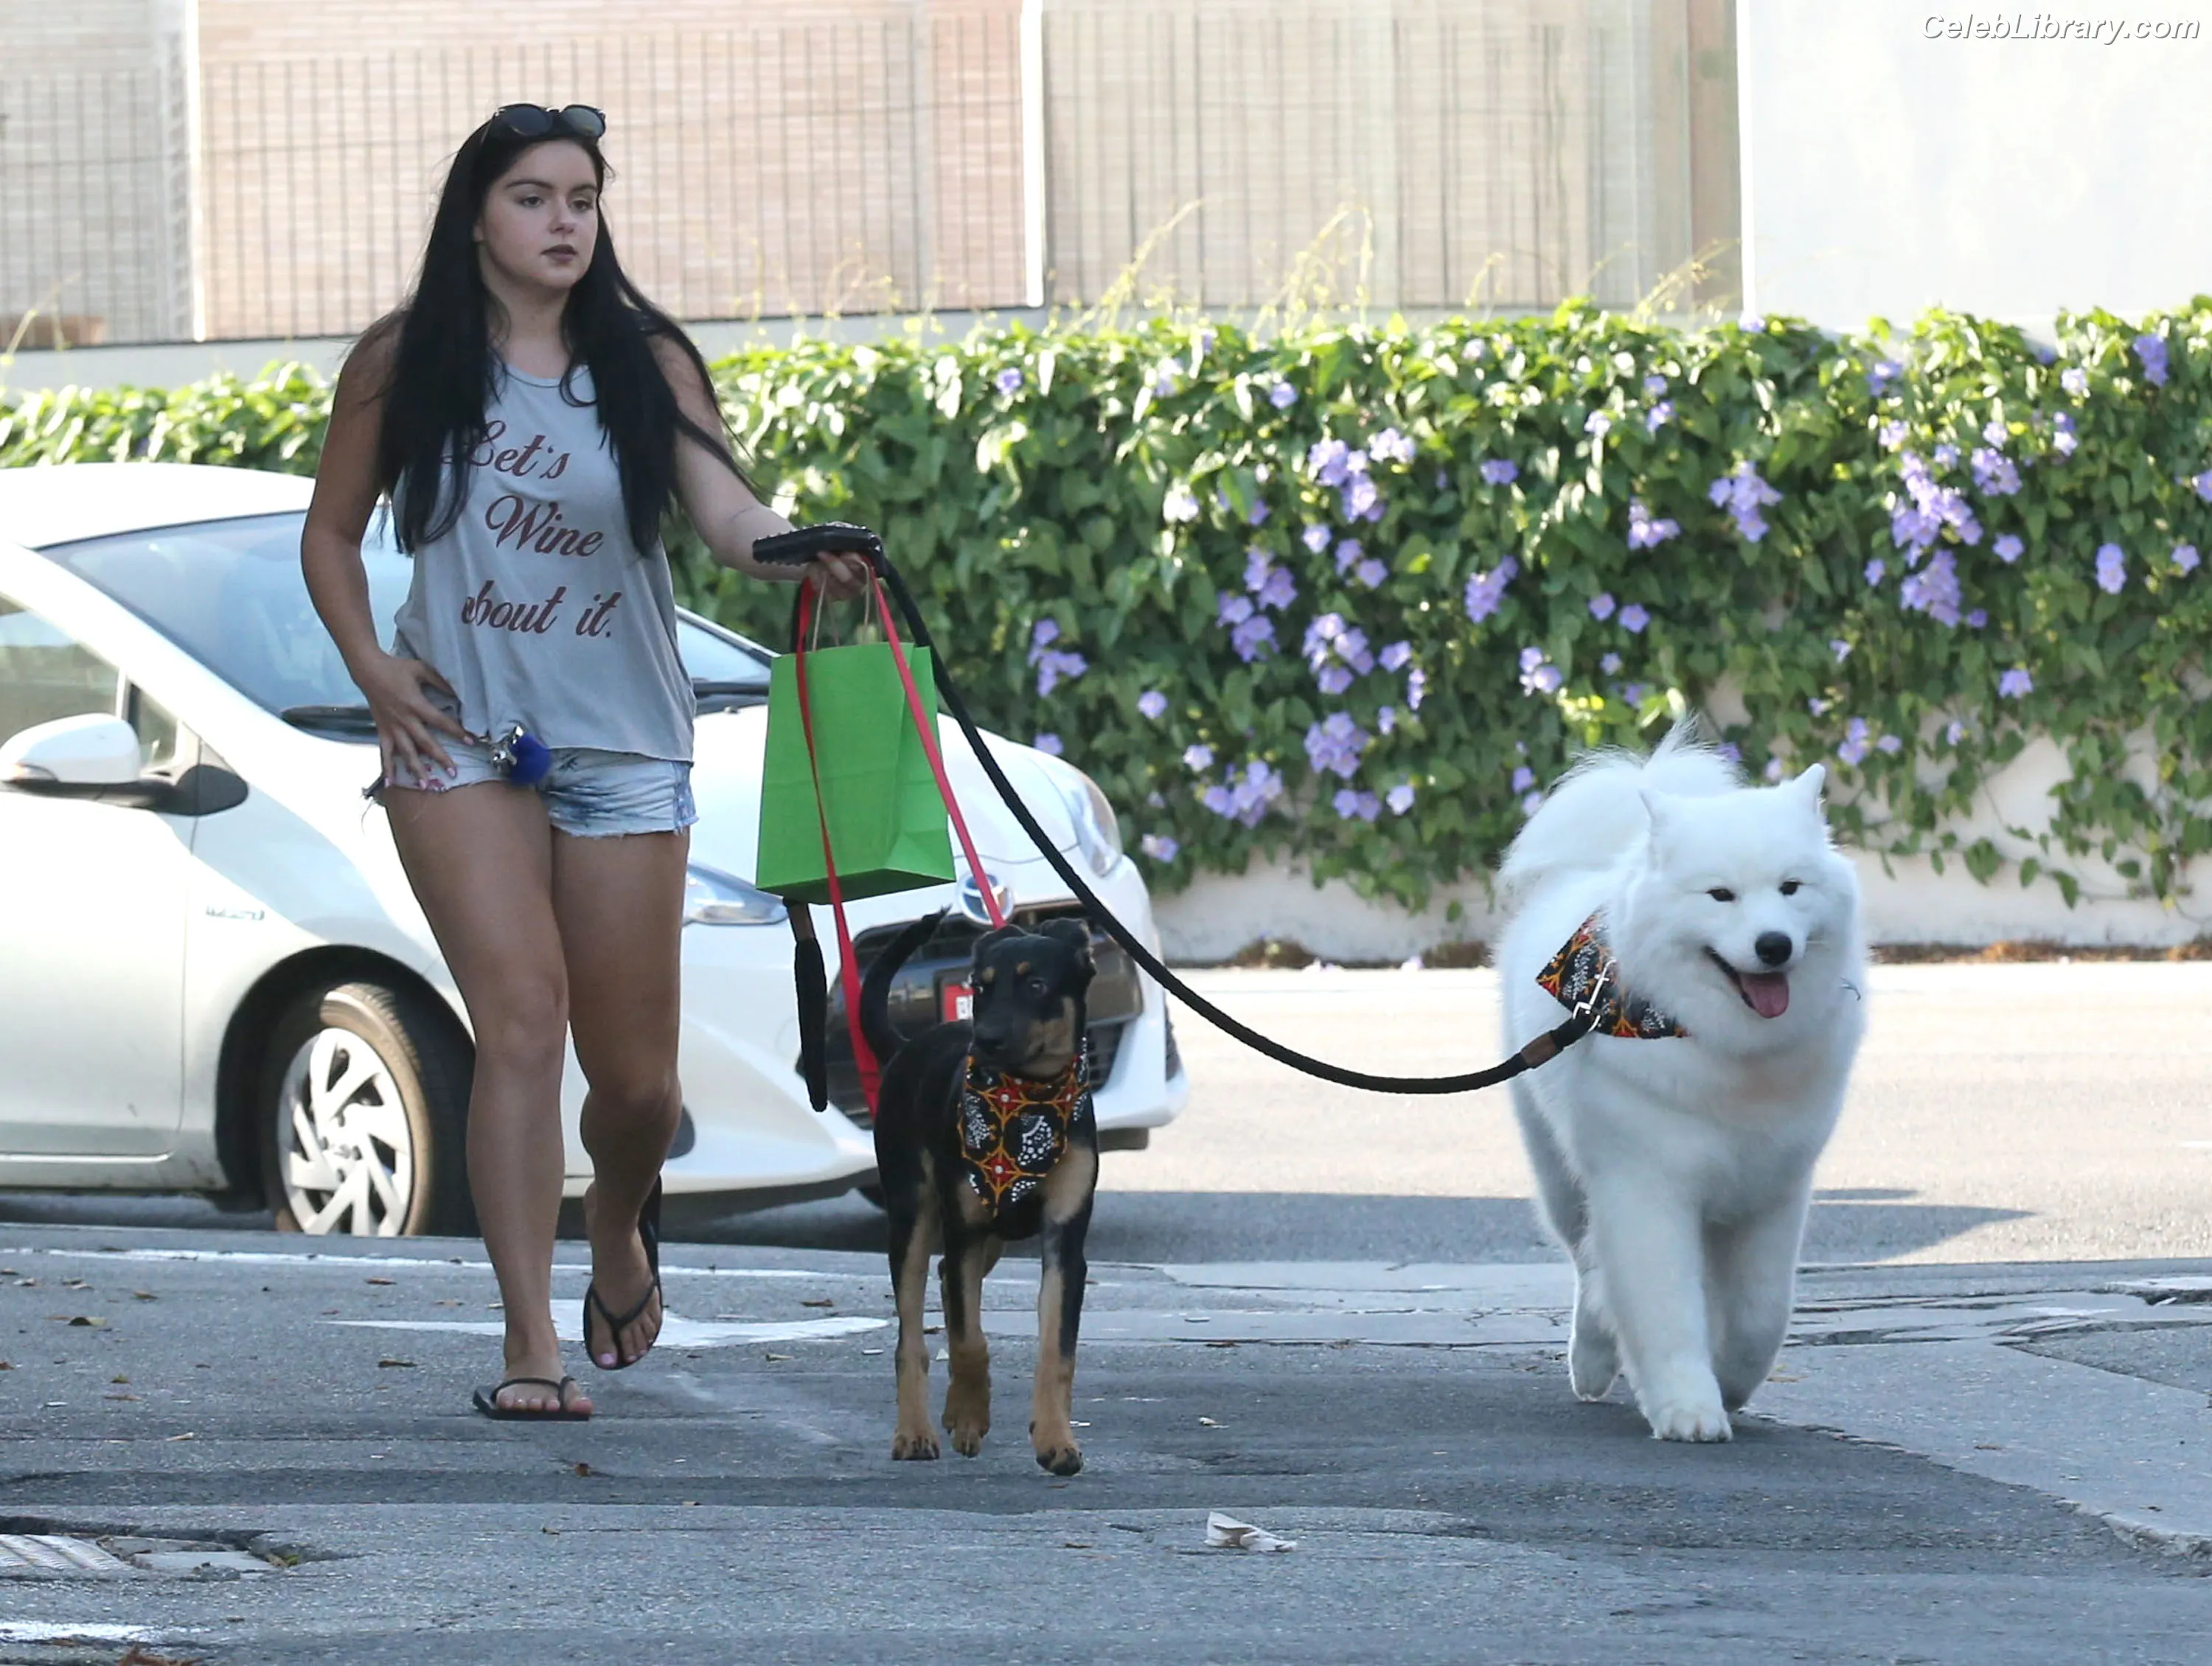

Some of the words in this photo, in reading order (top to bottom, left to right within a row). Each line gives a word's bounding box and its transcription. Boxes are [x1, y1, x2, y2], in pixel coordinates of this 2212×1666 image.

[441, 420, 571, 479] Let's
[484, 495, 604, 557] Wine
[462, 580, 566, 634] about
[575, 591, 622, 638] it.
